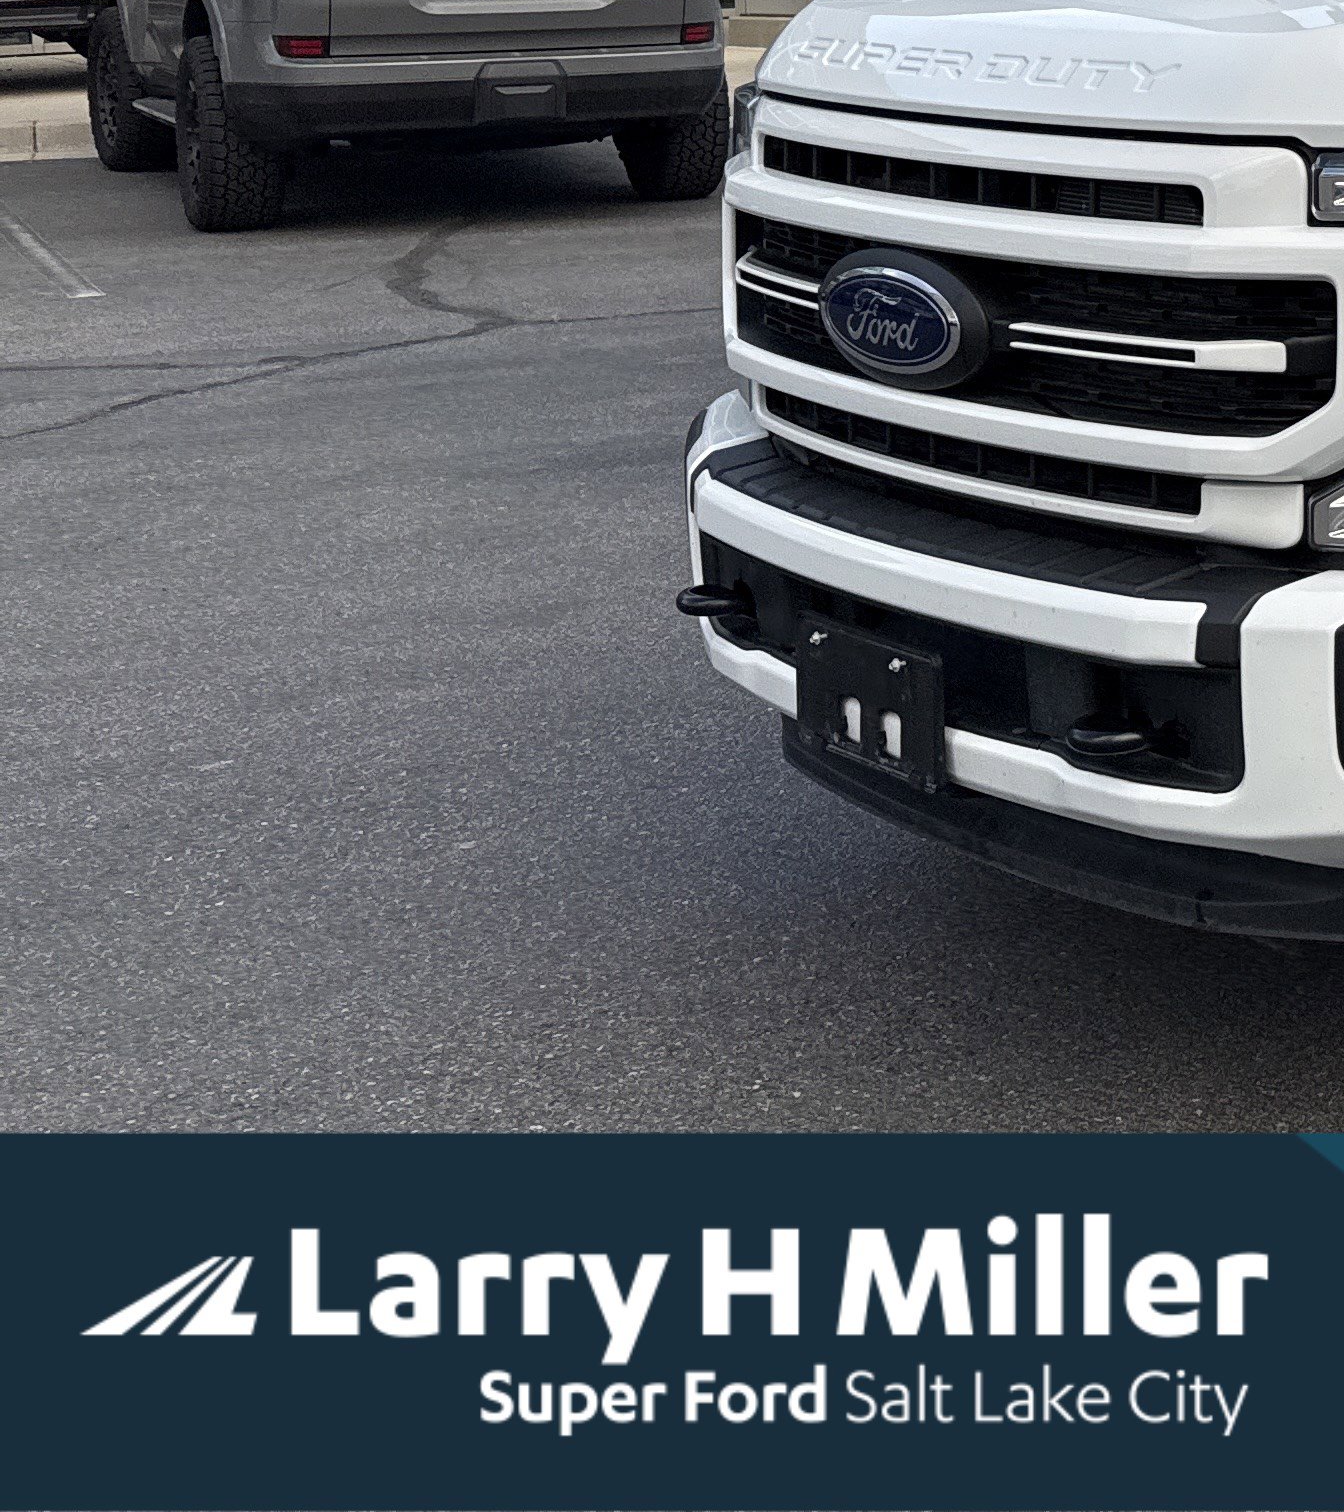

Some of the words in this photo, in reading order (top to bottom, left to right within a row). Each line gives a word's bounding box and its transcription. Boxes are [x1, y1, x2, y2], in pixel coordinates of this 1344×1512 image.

[793, 36, 973, 79] SUPER
[976, 53, 1182, 92] DUTY
[846, 287, 920, 351] Ford
